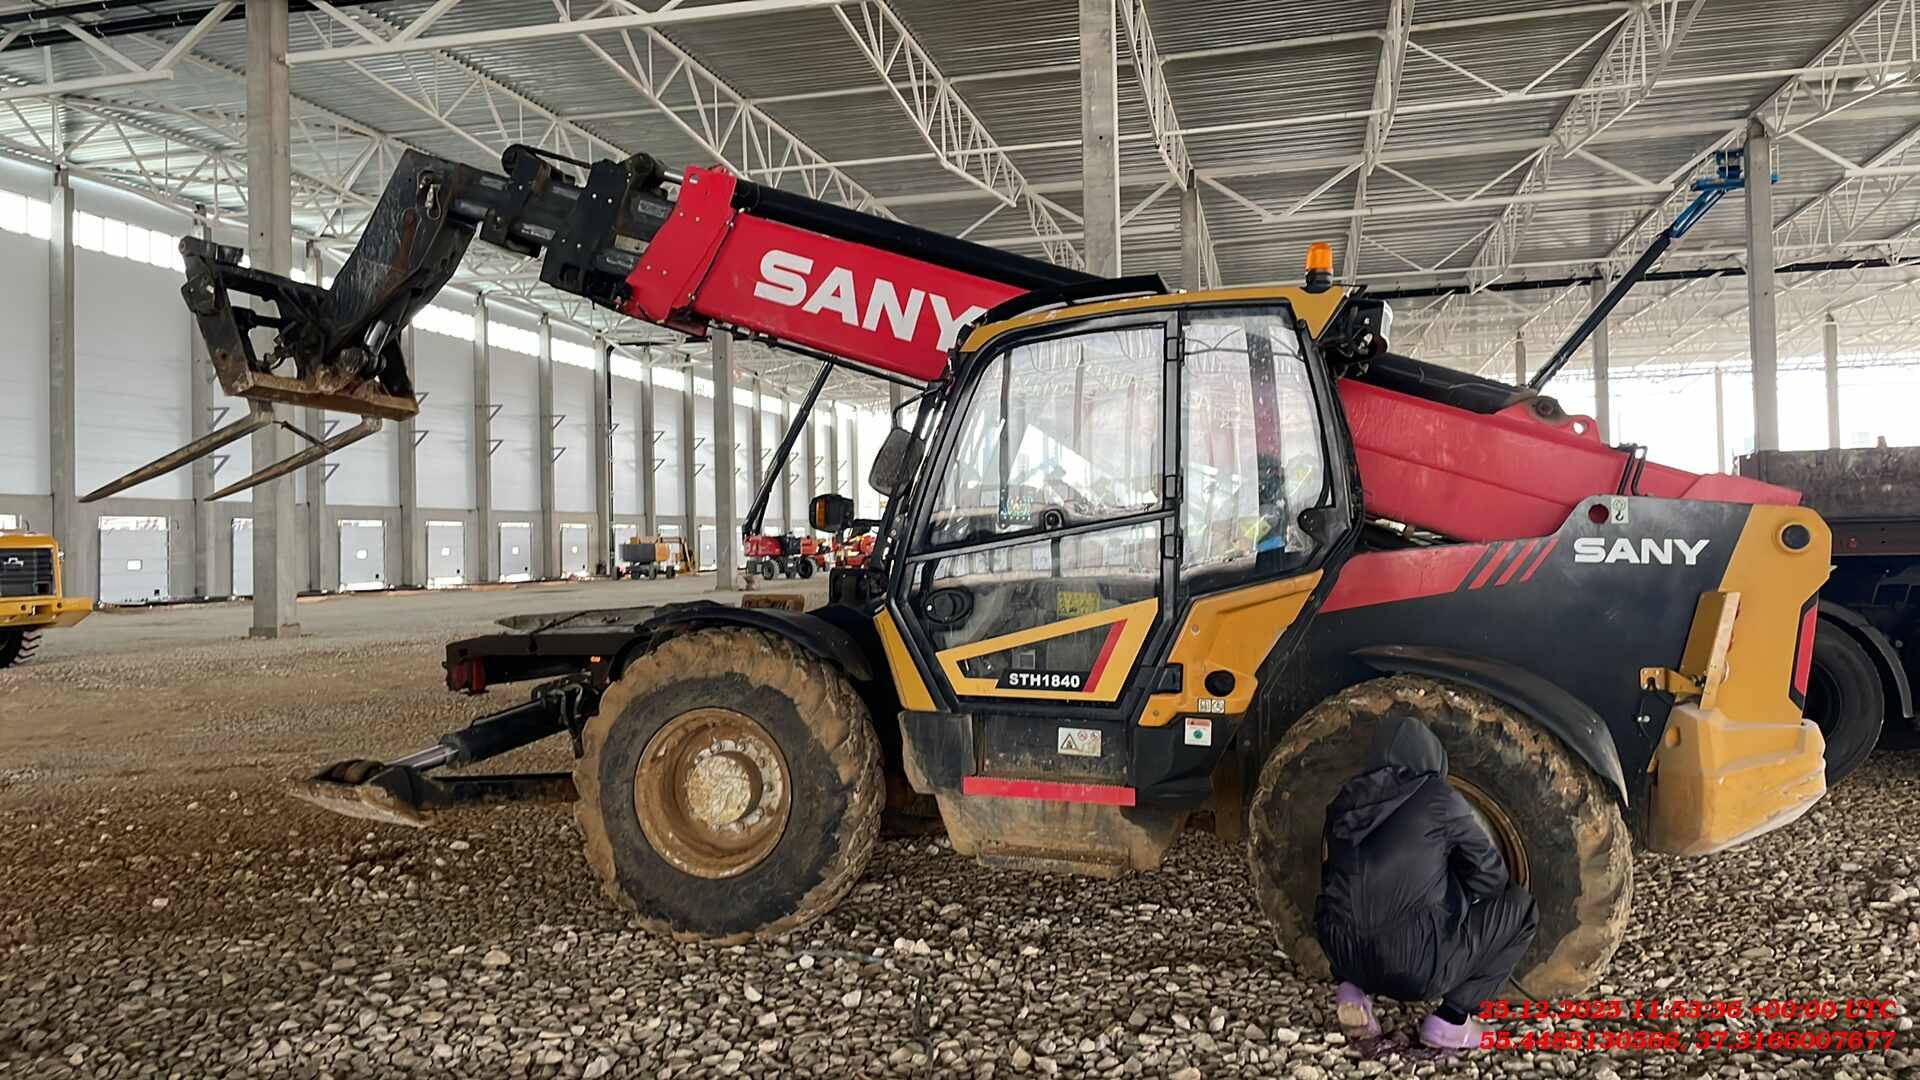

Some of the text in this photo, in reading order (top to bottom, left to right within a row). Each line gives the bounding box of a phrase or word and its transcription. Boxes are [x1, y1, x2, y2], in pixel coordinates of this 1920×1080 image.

[754, 250, 988, 350] SANY
[1573, 537, 1710, 566] SANY
[1009, 672, 1080, 688] STH1840
